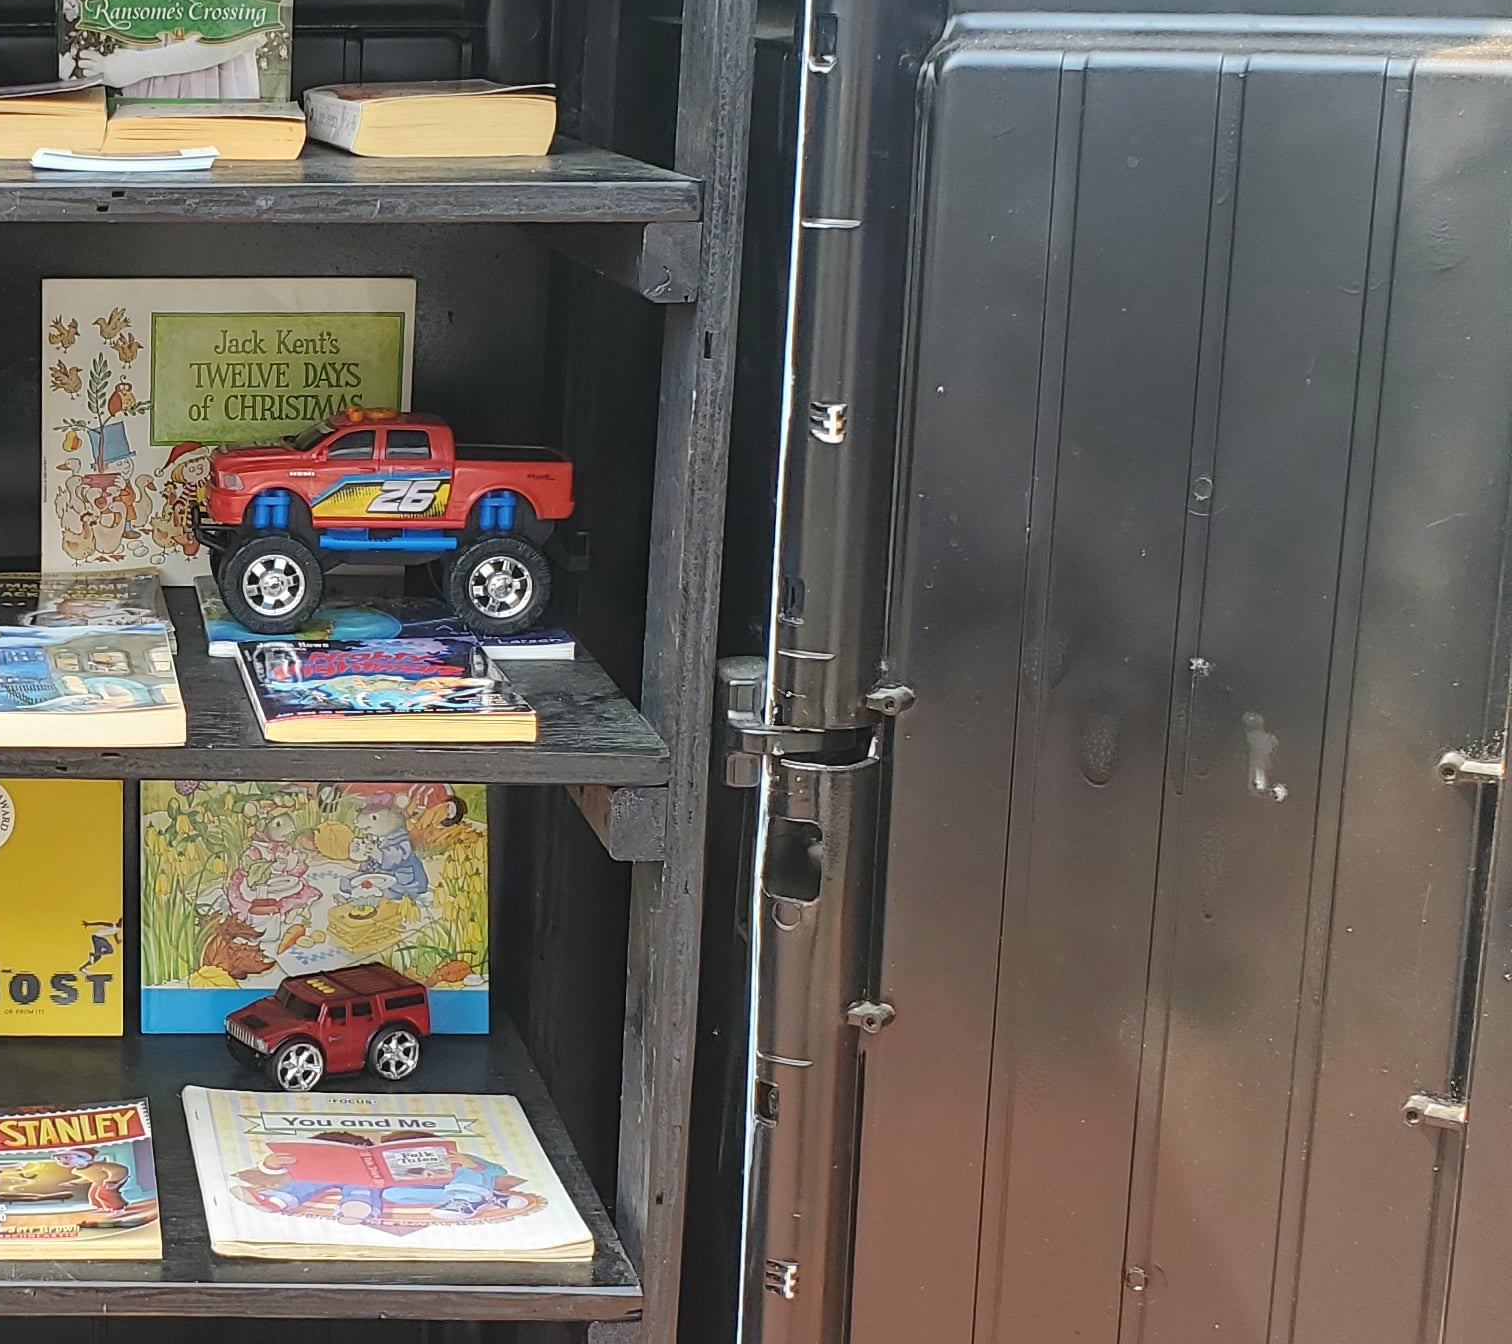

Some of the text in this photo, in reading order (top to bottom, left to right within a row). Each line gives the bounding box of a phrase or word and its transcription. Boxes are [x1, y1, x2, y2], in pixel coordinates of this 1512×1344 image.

[214, 330, 340, 356] Jack Kent's
[189, 361, 361, 388] TWELVE DAYS
[188, 396, 214, 424] of
[366, 480, 441, 514] 26
[1, 1110, 135, 1148] STANLEY
[282, 1117, 437, 1128] You and Me
